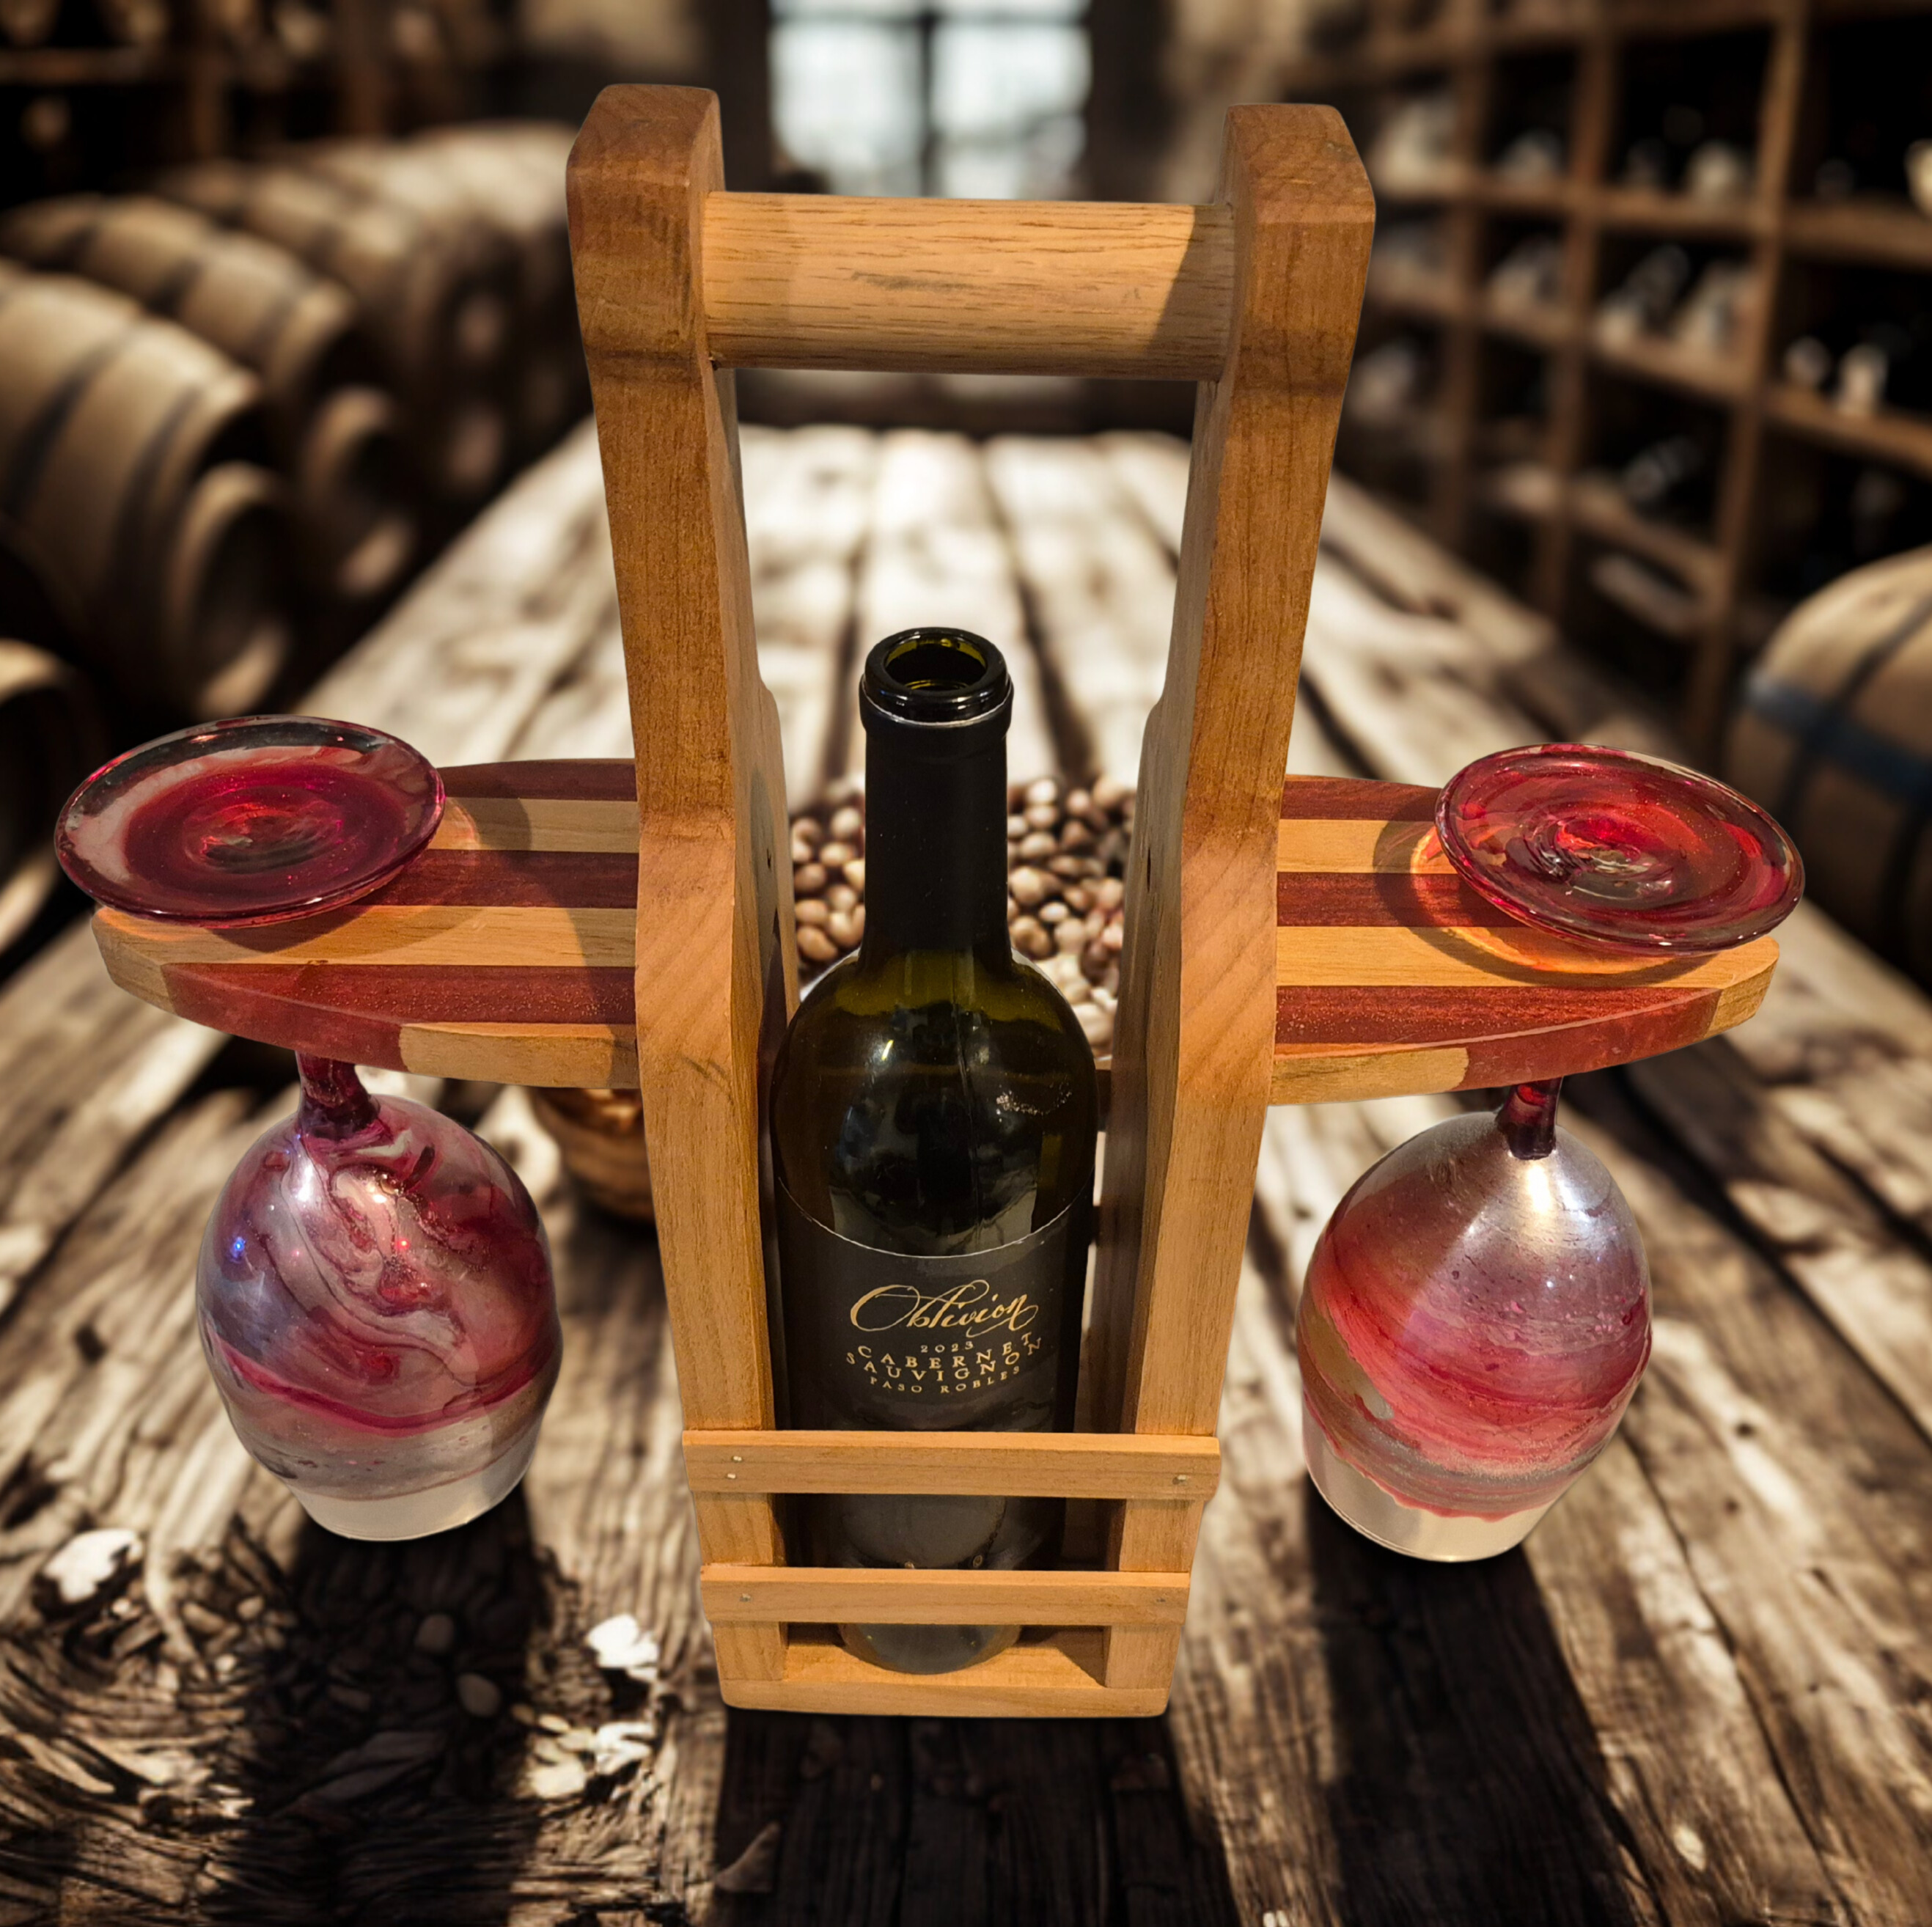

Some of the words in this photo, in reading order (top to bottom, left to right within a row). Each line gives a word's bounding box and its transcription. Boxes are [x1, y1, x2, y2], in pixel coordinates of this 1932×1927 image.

[850, 1279, 1039, 1338] Oblivion
[846, 1337, 1041, 1381] SAUVIGNON
[857, 1332, 1033, 1370] CABERNET
[870, 1376, 923, 1393] PASO
[940, 1365, 1021, 1394] ROBLES
